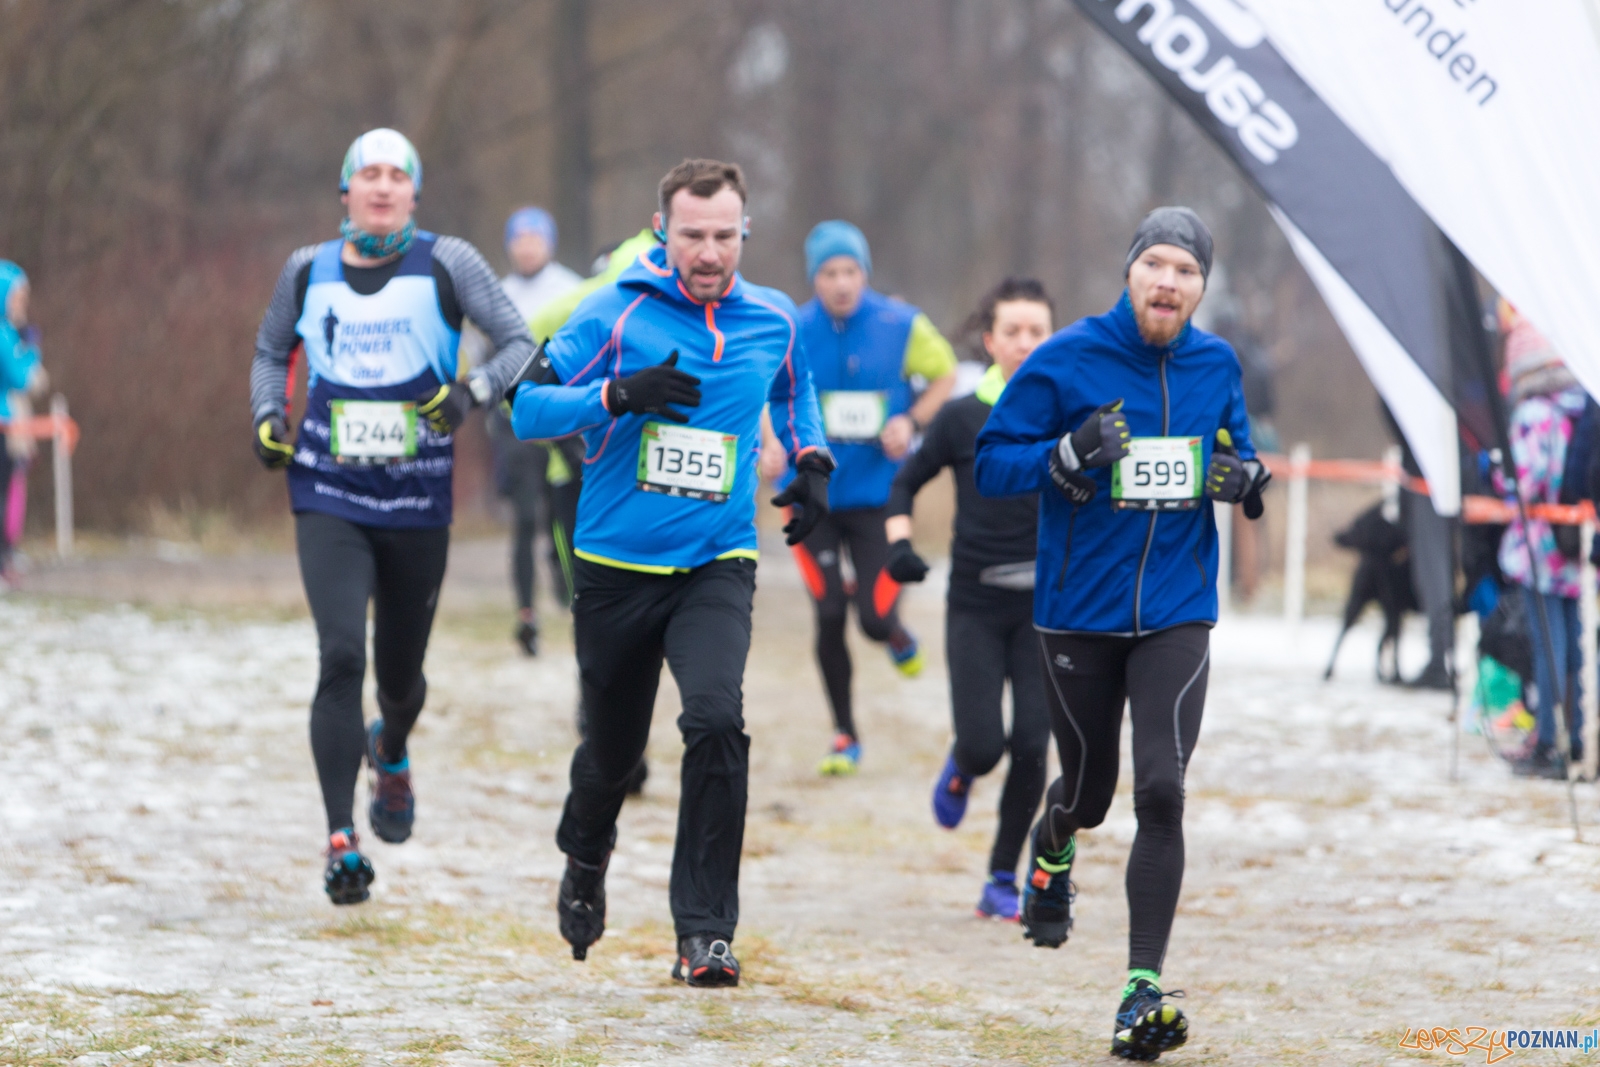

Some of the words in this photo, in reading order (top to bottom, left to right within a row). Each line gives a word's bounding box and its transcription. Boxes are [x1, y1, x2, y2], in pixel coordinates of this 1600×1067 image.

[340, 318, 411, 336] RUNNERS
[339, 337, 392, 355] POWER
[344, 421, 405, 443] 1244
[654, 446, 723, 479] 1355
[1134, 461, 1187, 486] 599
